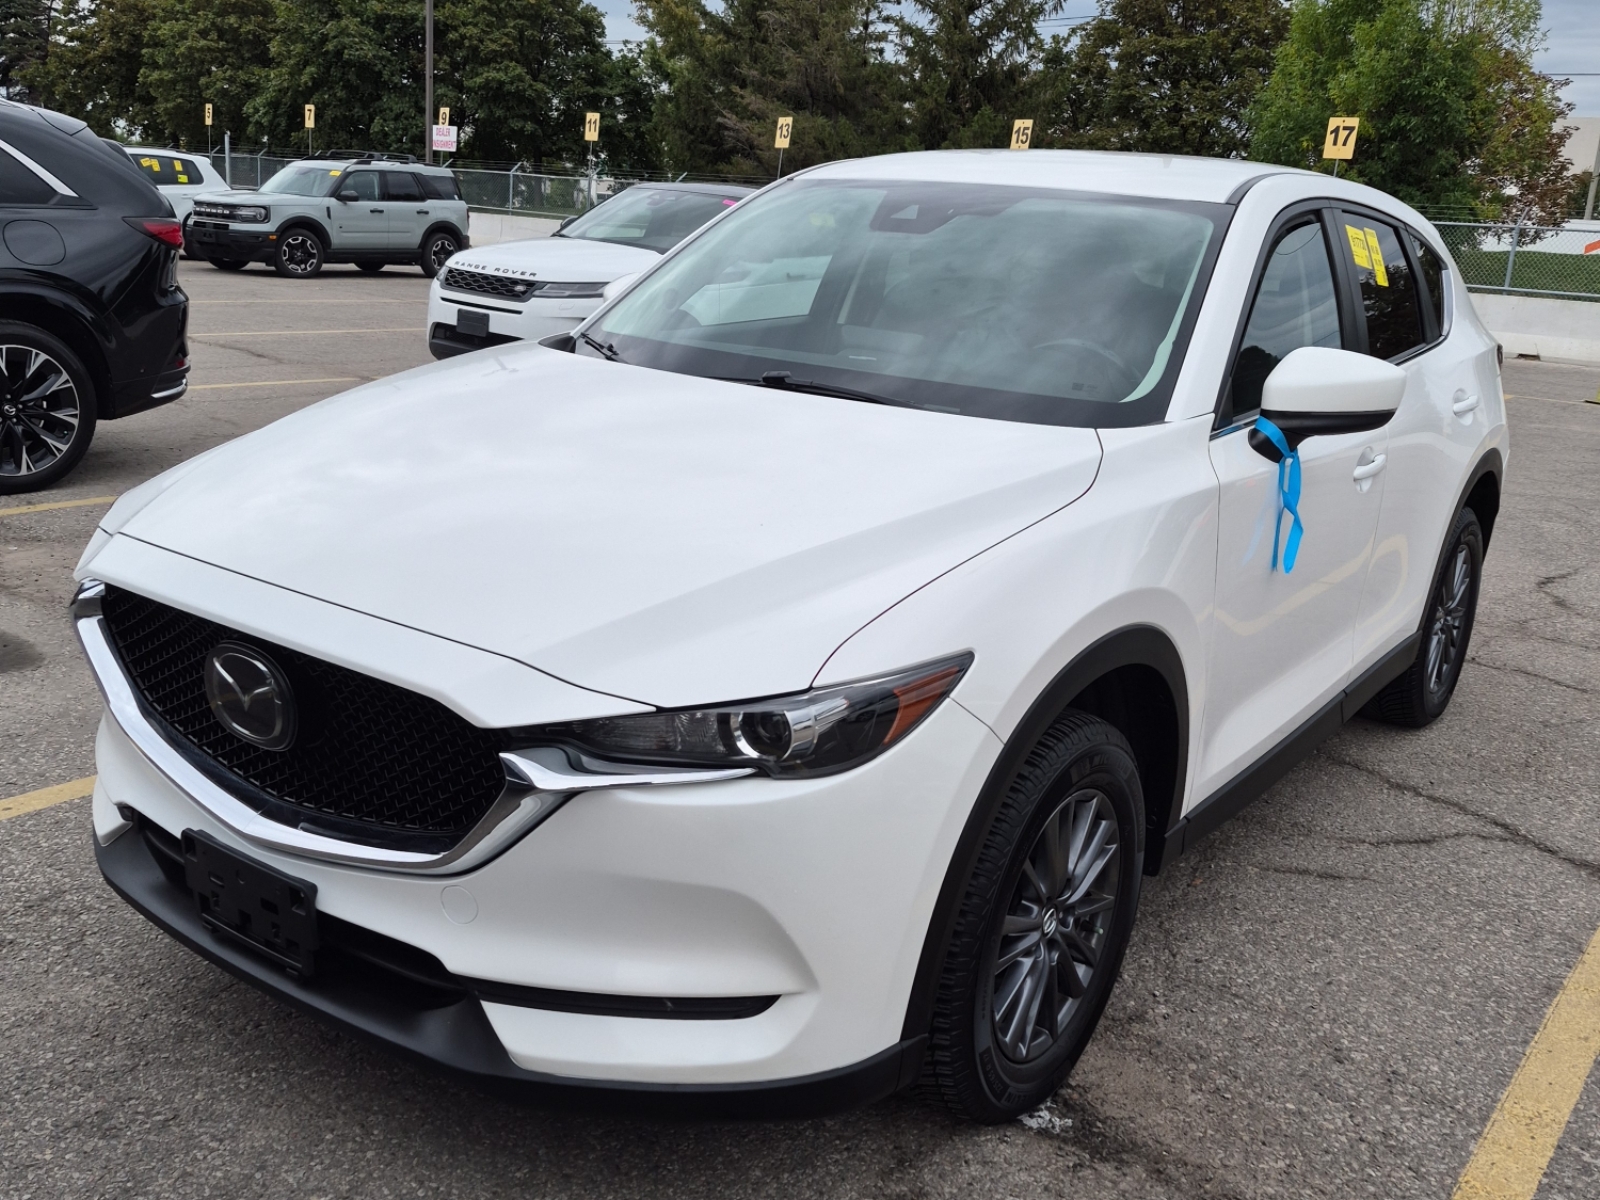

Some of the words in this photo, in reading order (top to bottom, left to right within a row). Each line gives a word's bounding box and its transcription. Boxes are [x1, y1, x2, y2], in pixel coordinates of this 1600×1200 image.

[307, 108, 313, 121] 7
[441, 111, 447, 125] 9
[435, 127, 451, 137] DEALER
[587, 118, 597, 132] 11
[778, 123, 791, 139] 13
[1013, 126, 1030, 145] 15
[1329, 125, 1356, 147] 17
[454, 260, 487, 271] RANGE
[494, 267, 537, 278] ROVER
